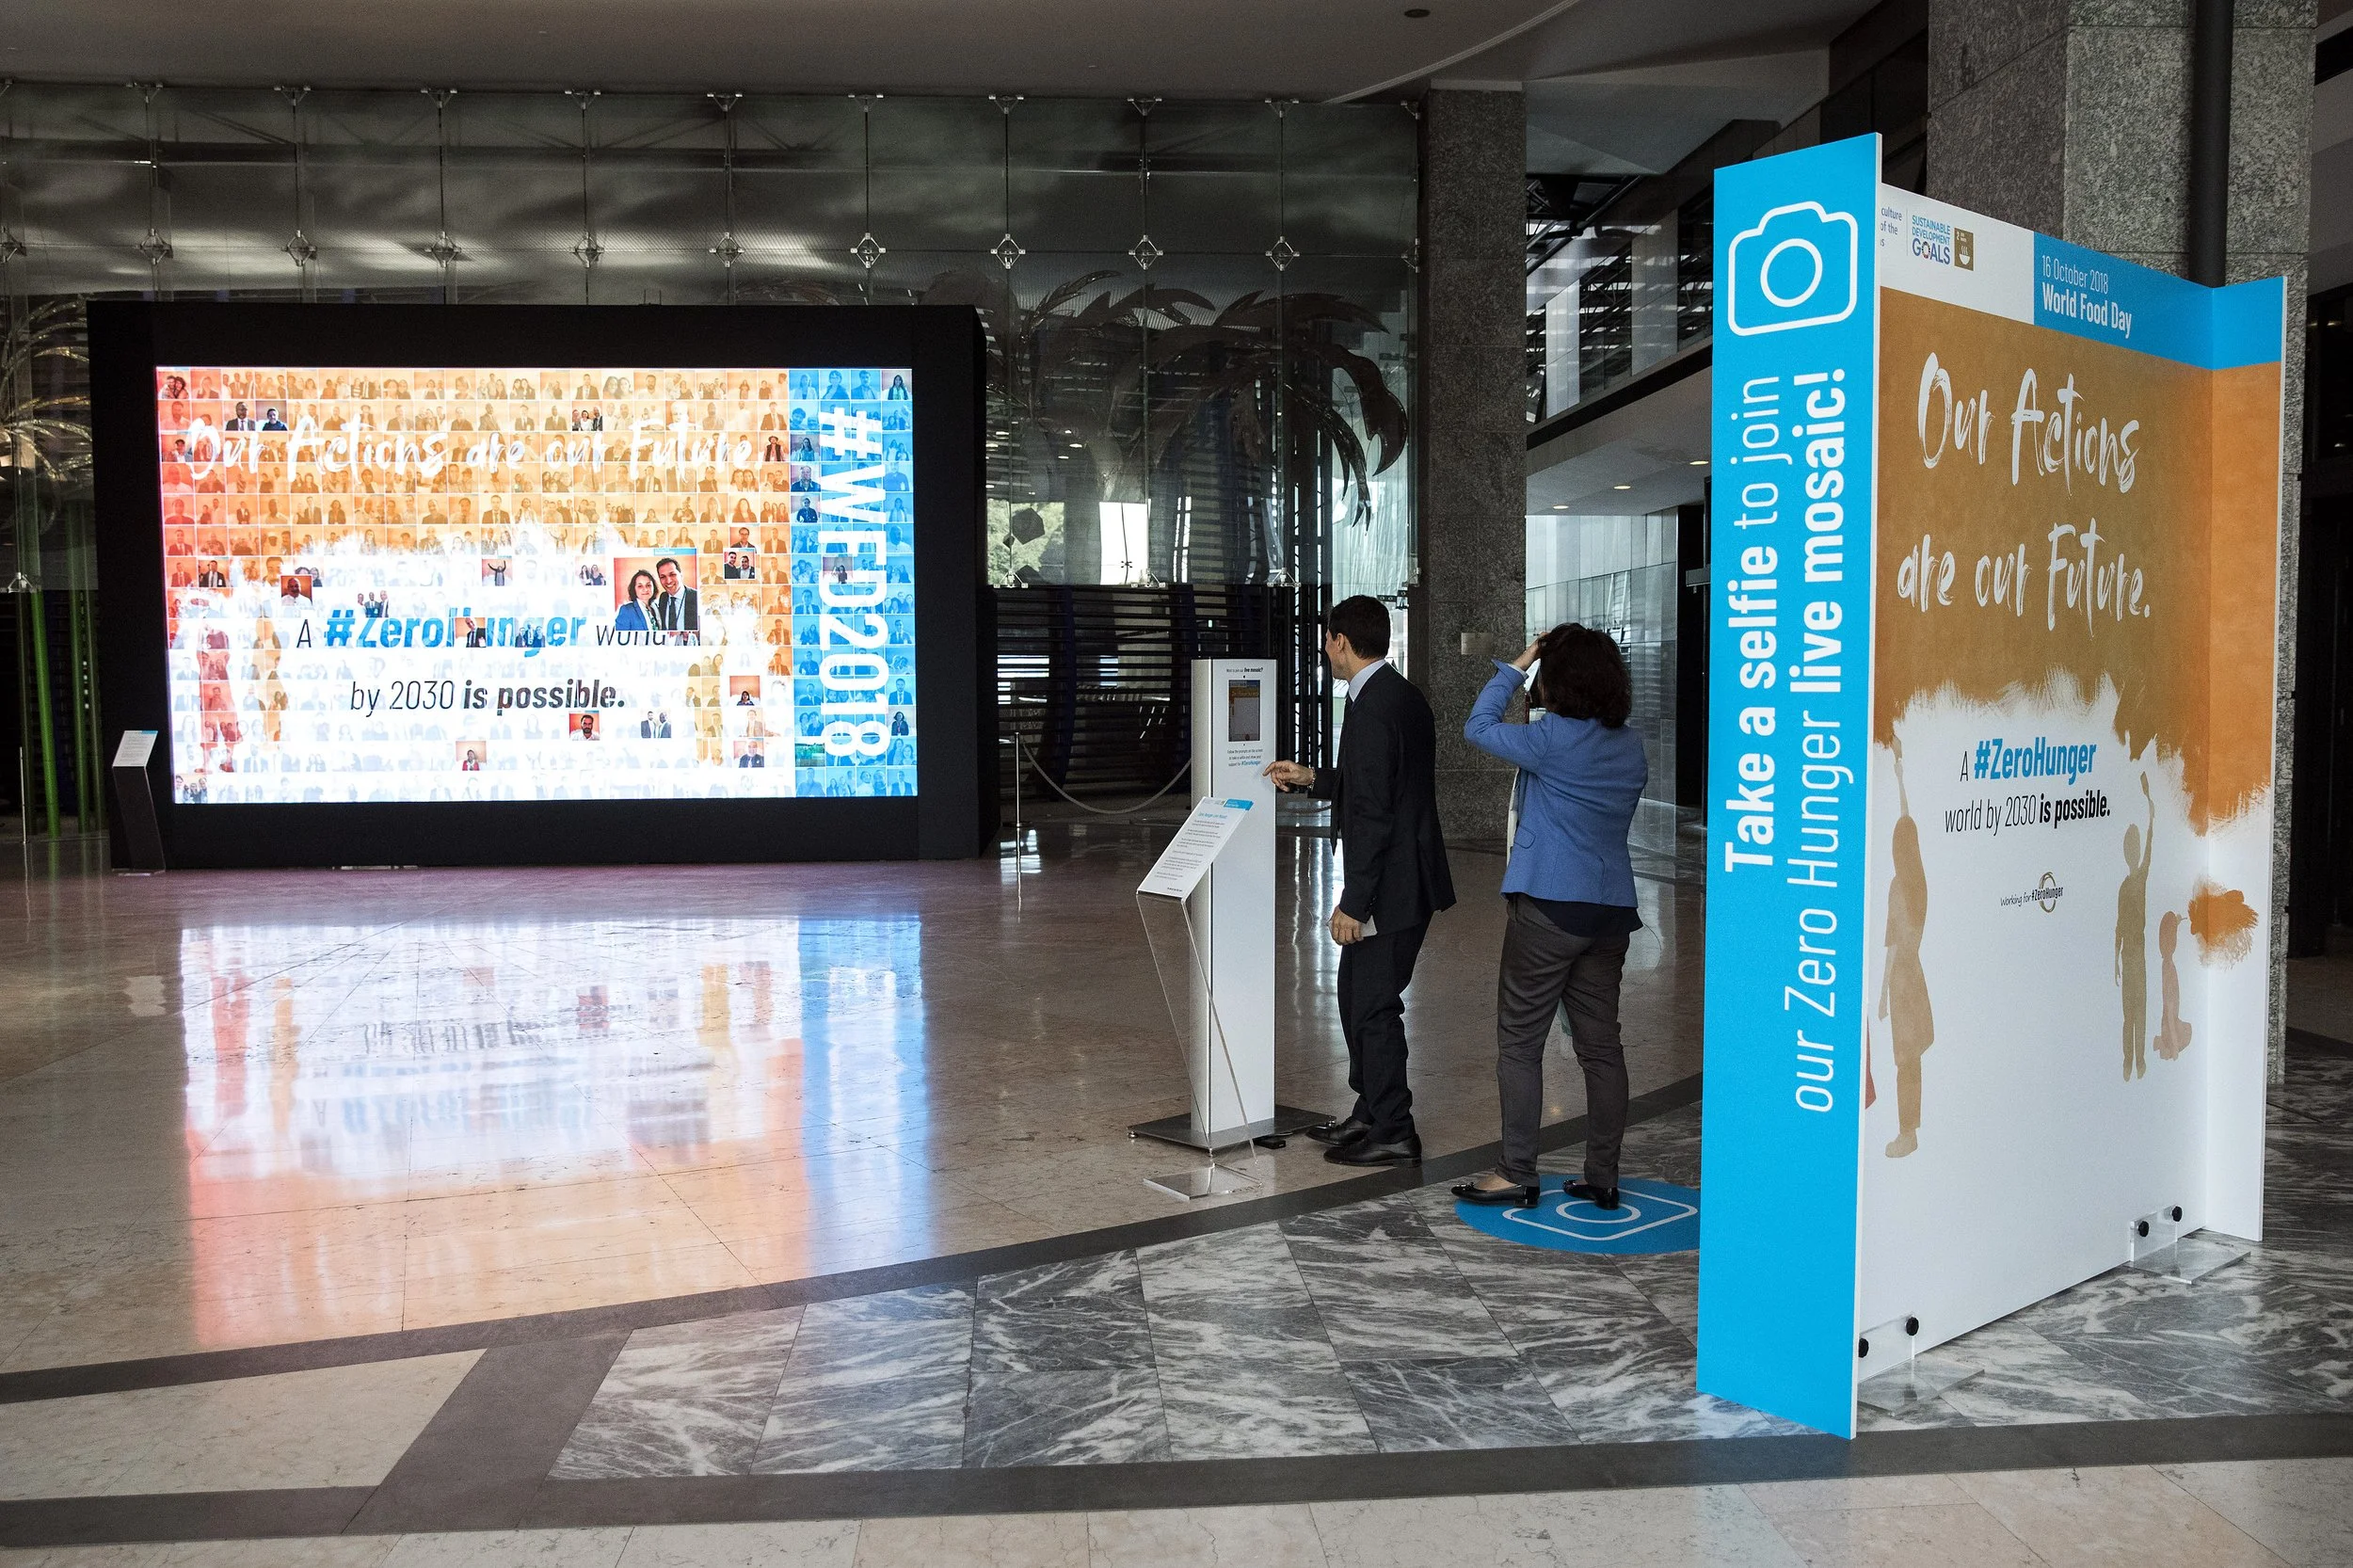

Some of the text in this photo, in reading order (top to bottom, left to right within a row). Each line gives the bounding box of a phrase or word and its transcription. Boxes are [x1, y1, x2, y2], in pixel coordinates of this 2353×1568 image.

[1888, 222, 1897, 235] the
[1913, 215, 1950, 235] SUSTAINABLE
[1913, 227, 1950, 245] DEVELOPMENT
[1913, 237, 1950, 264] GOALS
[2042, 254, 2108, 295] 16 October 2018
[2042, 282, 2132, 339] World Food Day
[1918, 352, 2139, 497] Our Actions
[187, 417, 266, 479] Our
[283, 413, 448, 483] Actions
[466, 432, 526, 473] are
[546, 432, 611, 472] our
[818, 407, 890, 758] #WED2018
[1897, 518, 2150, 641] are our Future.
[296, 618, 312, 648] A
[1725, 376, 1792, 872] Take a selfie to join
[350, 679, 625, 717] by 2030 is possible.
[1785, 368, 1853, 1112] our Zero Hunger live mosaic!
[1960, 737, 2097, 785] A #ZeroHunger
[1945, 790, 2110, 836] world by 2030 is possible.
[2032, 888, 2063, 901] #ZeroHunger
